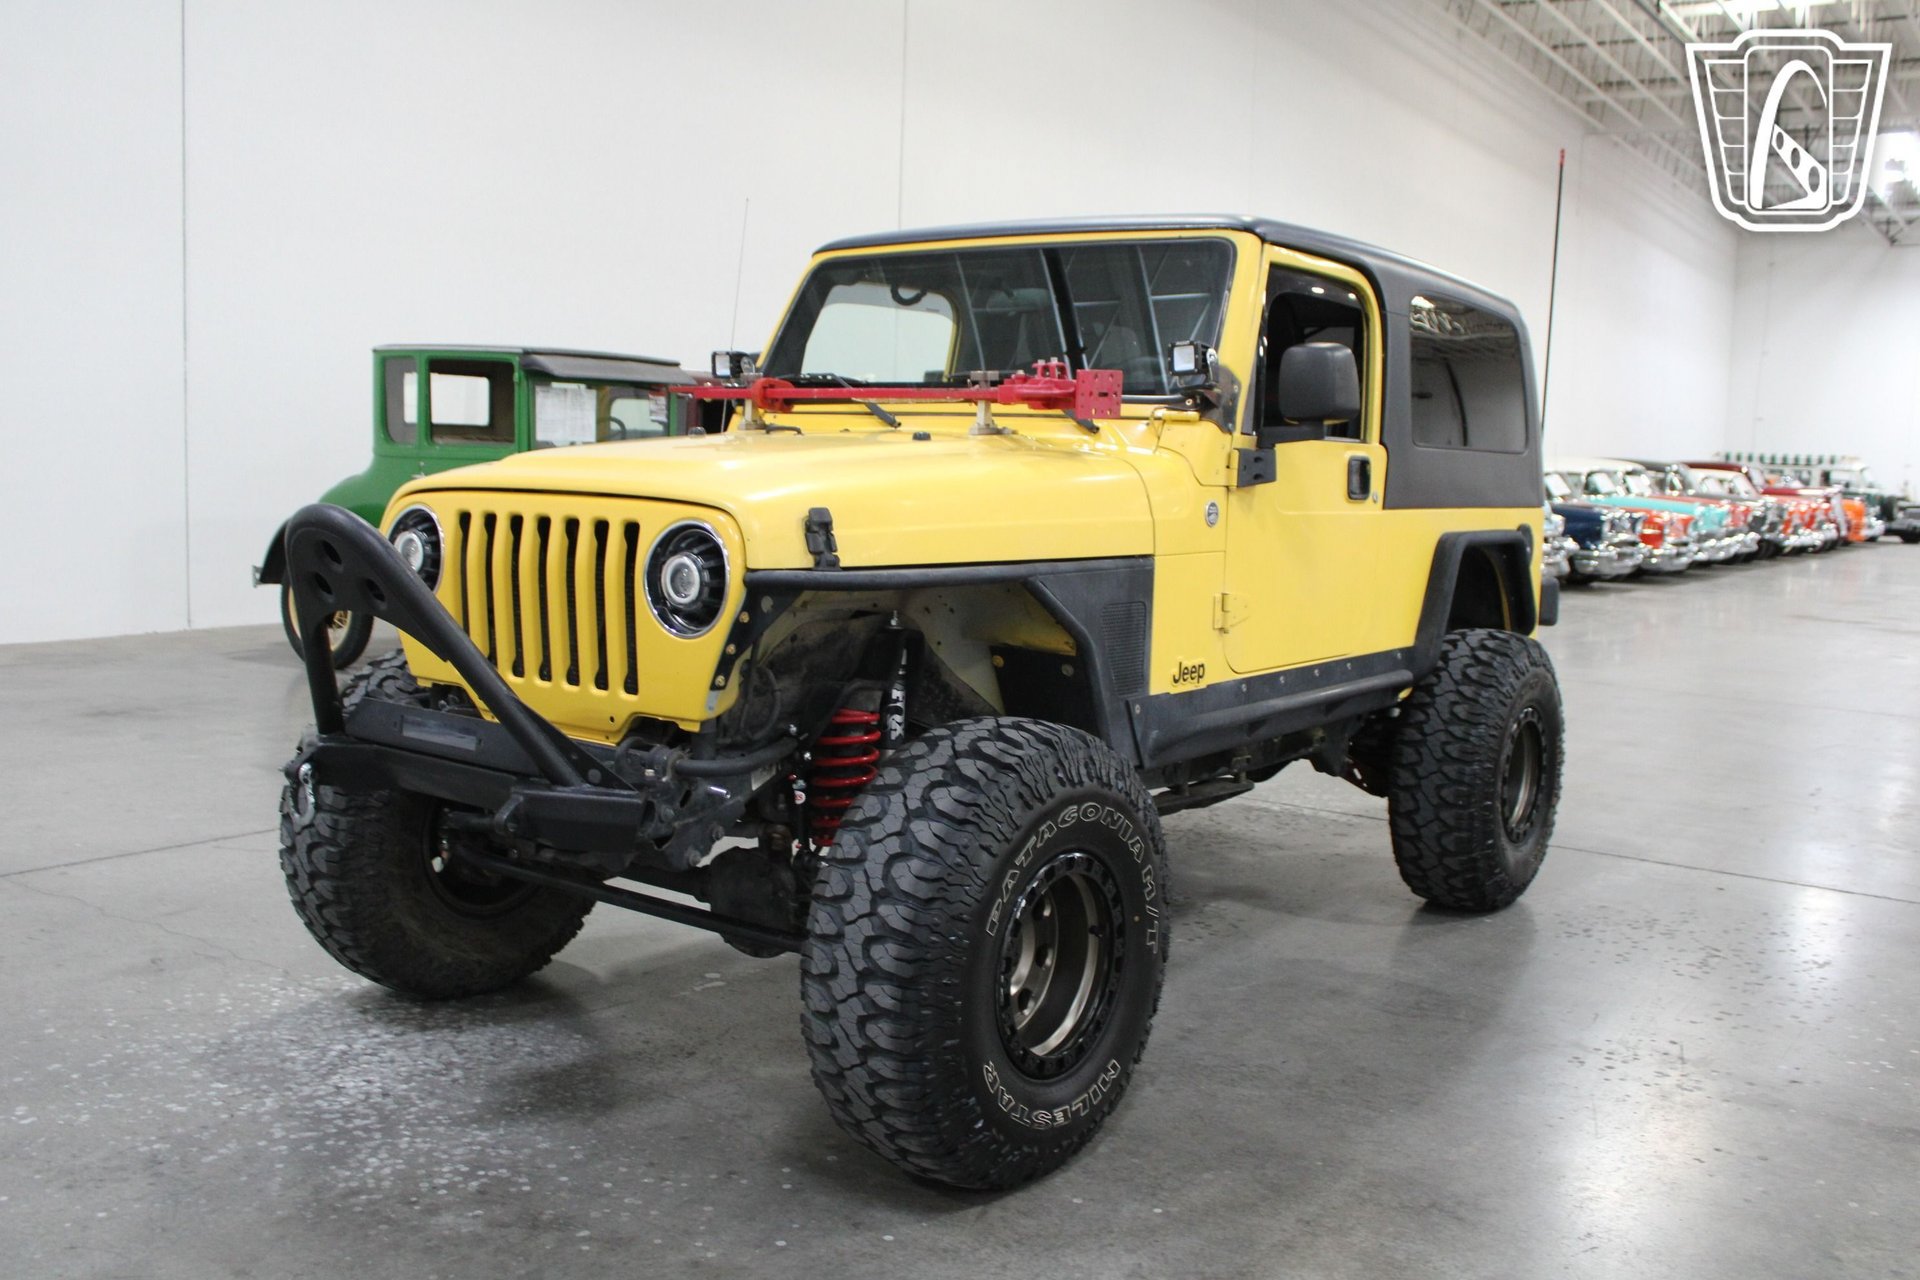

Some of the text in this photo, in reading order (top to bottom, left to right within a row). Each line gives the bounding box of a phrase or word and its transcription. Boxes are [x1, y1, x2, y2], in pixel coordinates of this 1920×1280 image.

[1172, 661, 1206, 684] Jeep
[985, 801, 1161, 955] PATAGONIA M/T
[982, 1058, 1122, 1130] MILESTAR
